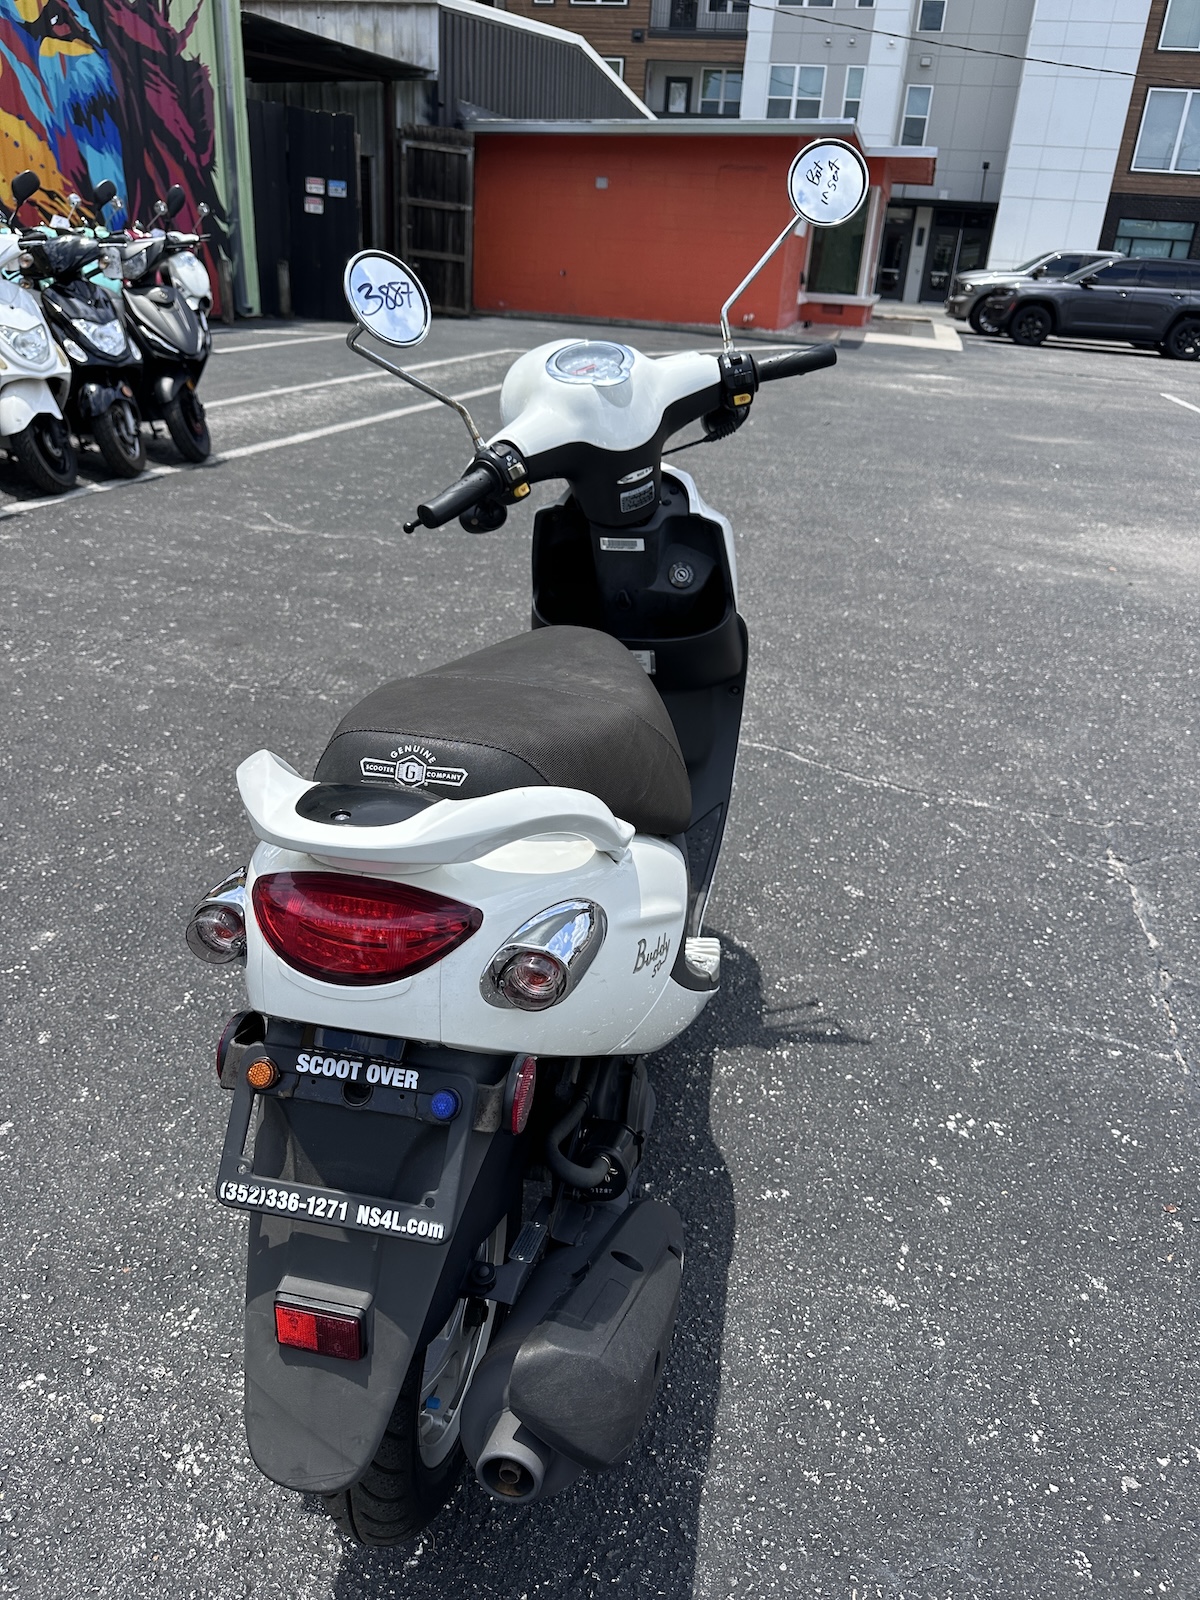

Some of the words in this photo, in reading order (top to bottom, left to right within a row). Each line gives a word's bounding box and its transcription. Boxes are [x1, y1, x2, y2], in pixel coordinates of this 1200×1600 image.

[357, 281, 414, 316] 3887
[390, 745, 437, 764] GENUINE
[365, 764, 394, 772] SCOOTER
[405, 764, 416, 780] G
[426, 771, 462, 781] COMPANY
[632, 932, 671, 974] Buddy
[651, 960, 662, 978] 50
[295, 1052, 363, 1081] SCOOT
[366, 1062, 420, 1090] OVER
[219, 1180, 348, 1220] (352)336-1271
[356, 1204, 445, 1240] NS4L.com
